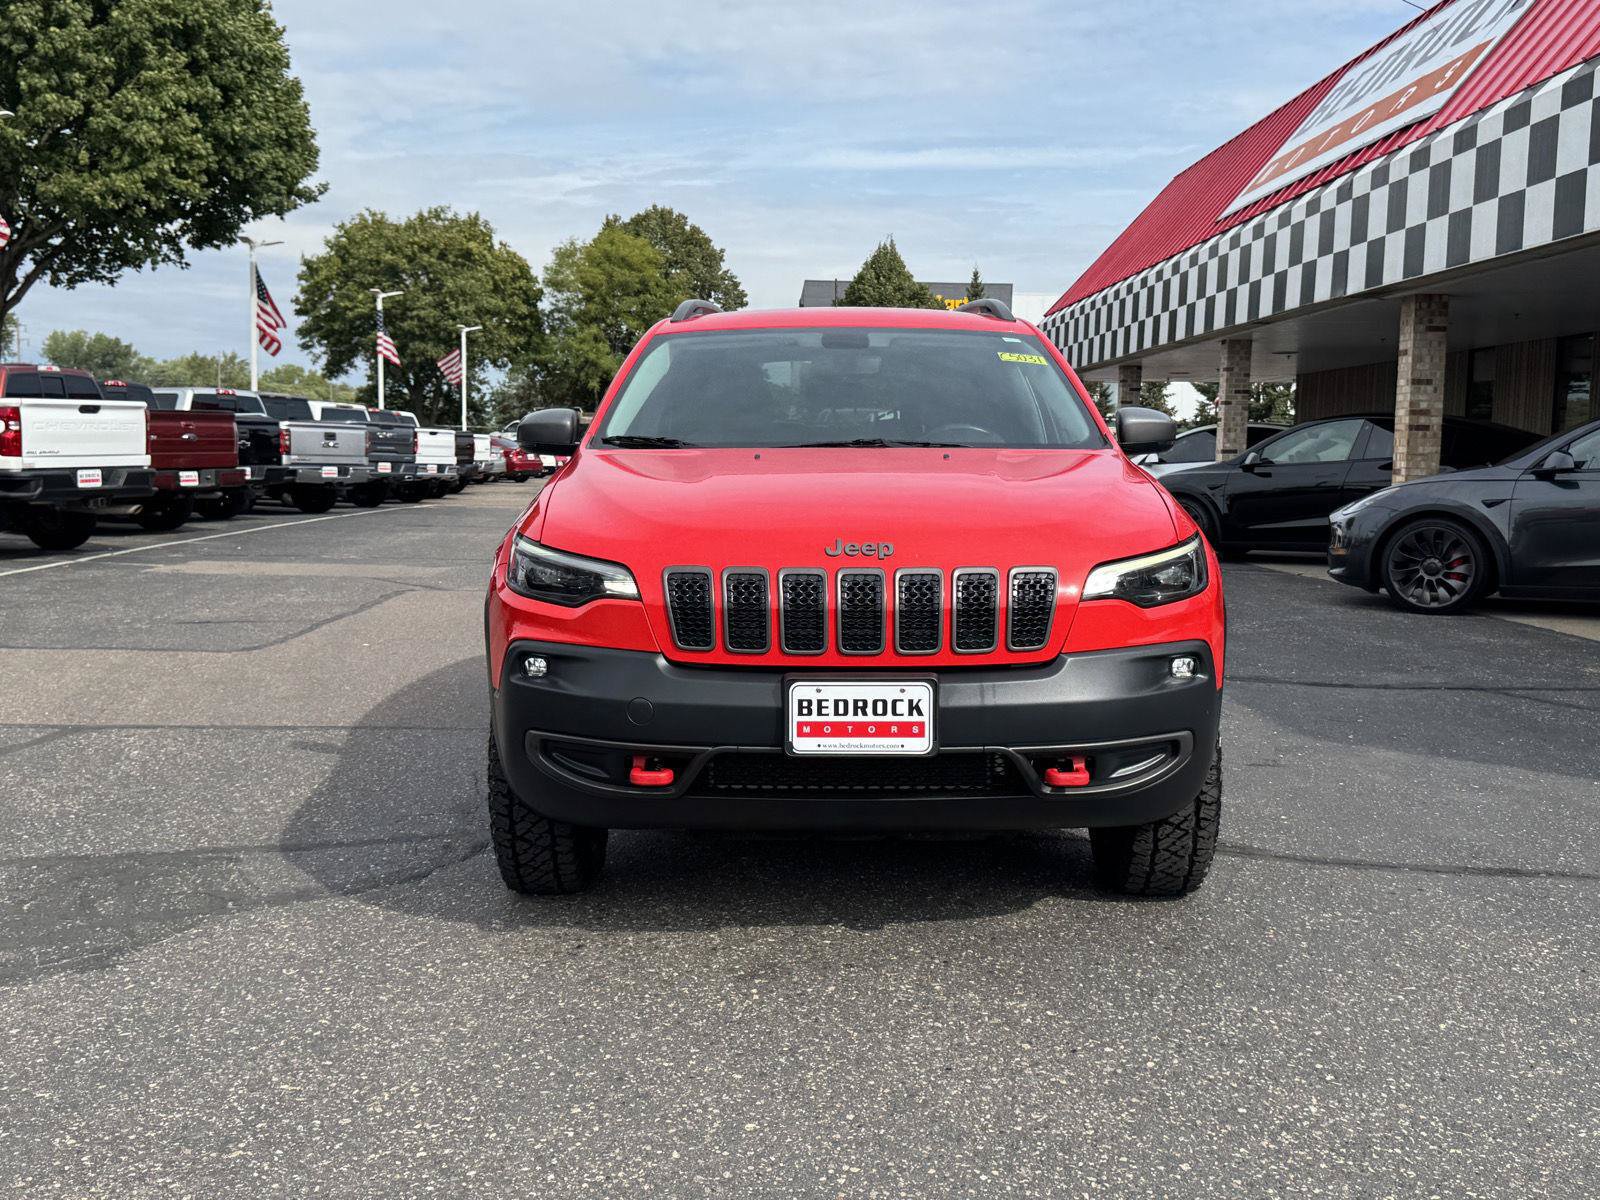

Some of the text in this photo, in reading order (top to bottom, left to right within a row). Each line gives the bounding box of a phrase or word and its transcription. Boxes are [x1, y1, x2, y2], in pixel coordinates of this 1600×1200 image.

[1258, 59, 1463, 183] MOTORS
[32, 419, 138, 432] CHEVROLET
[825, 538, 894, 560] Jeep
[797, 699, 924, 717] BEDROCK
